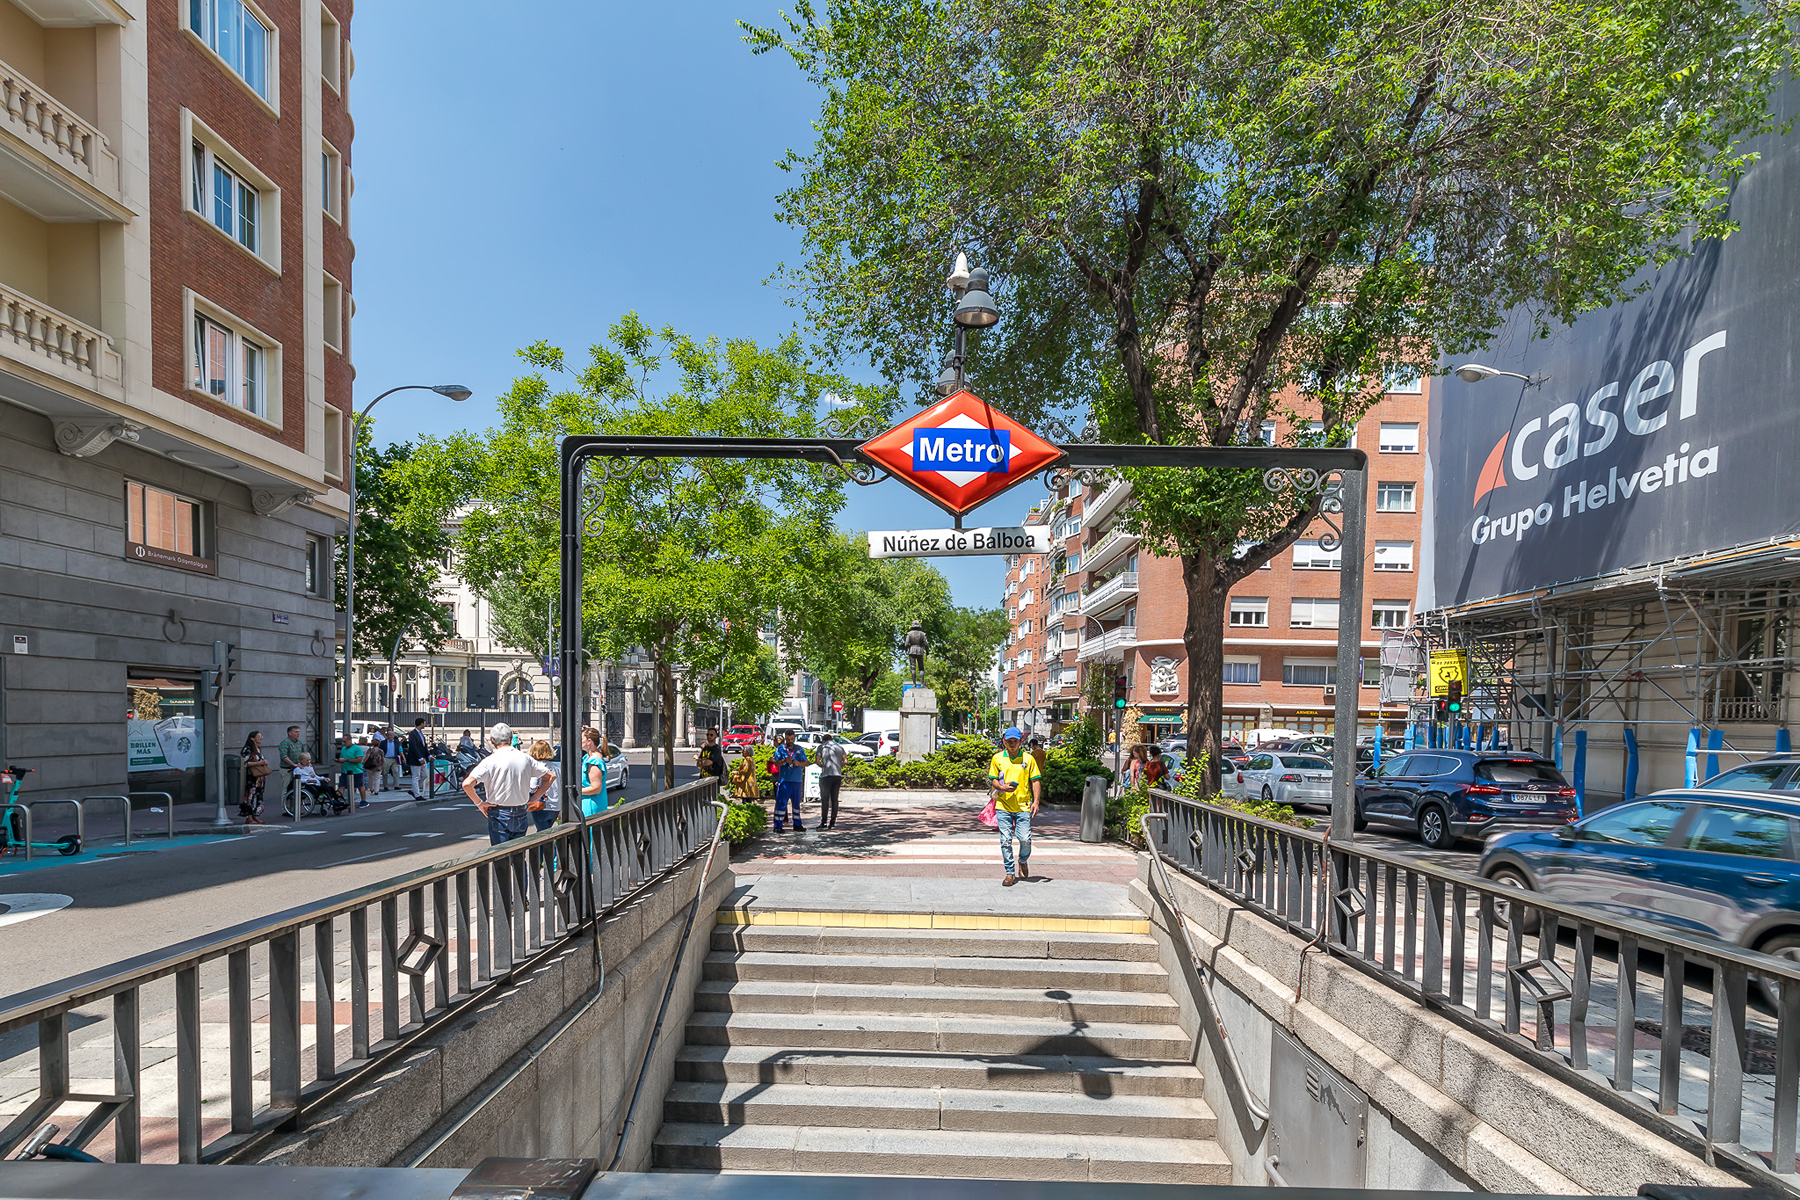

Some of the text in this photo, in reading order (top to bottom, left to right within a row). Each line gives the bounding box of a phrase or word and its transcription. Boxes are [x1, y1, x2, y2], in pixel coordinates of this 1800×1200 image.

[1511, 330, 1727, 481] caser
[919, 437, 1004, 464] Metro
[1471, 442, 1719, 545] Grupo Helvetia
[883, 532, 1035, 552] Núñez de Balboa
